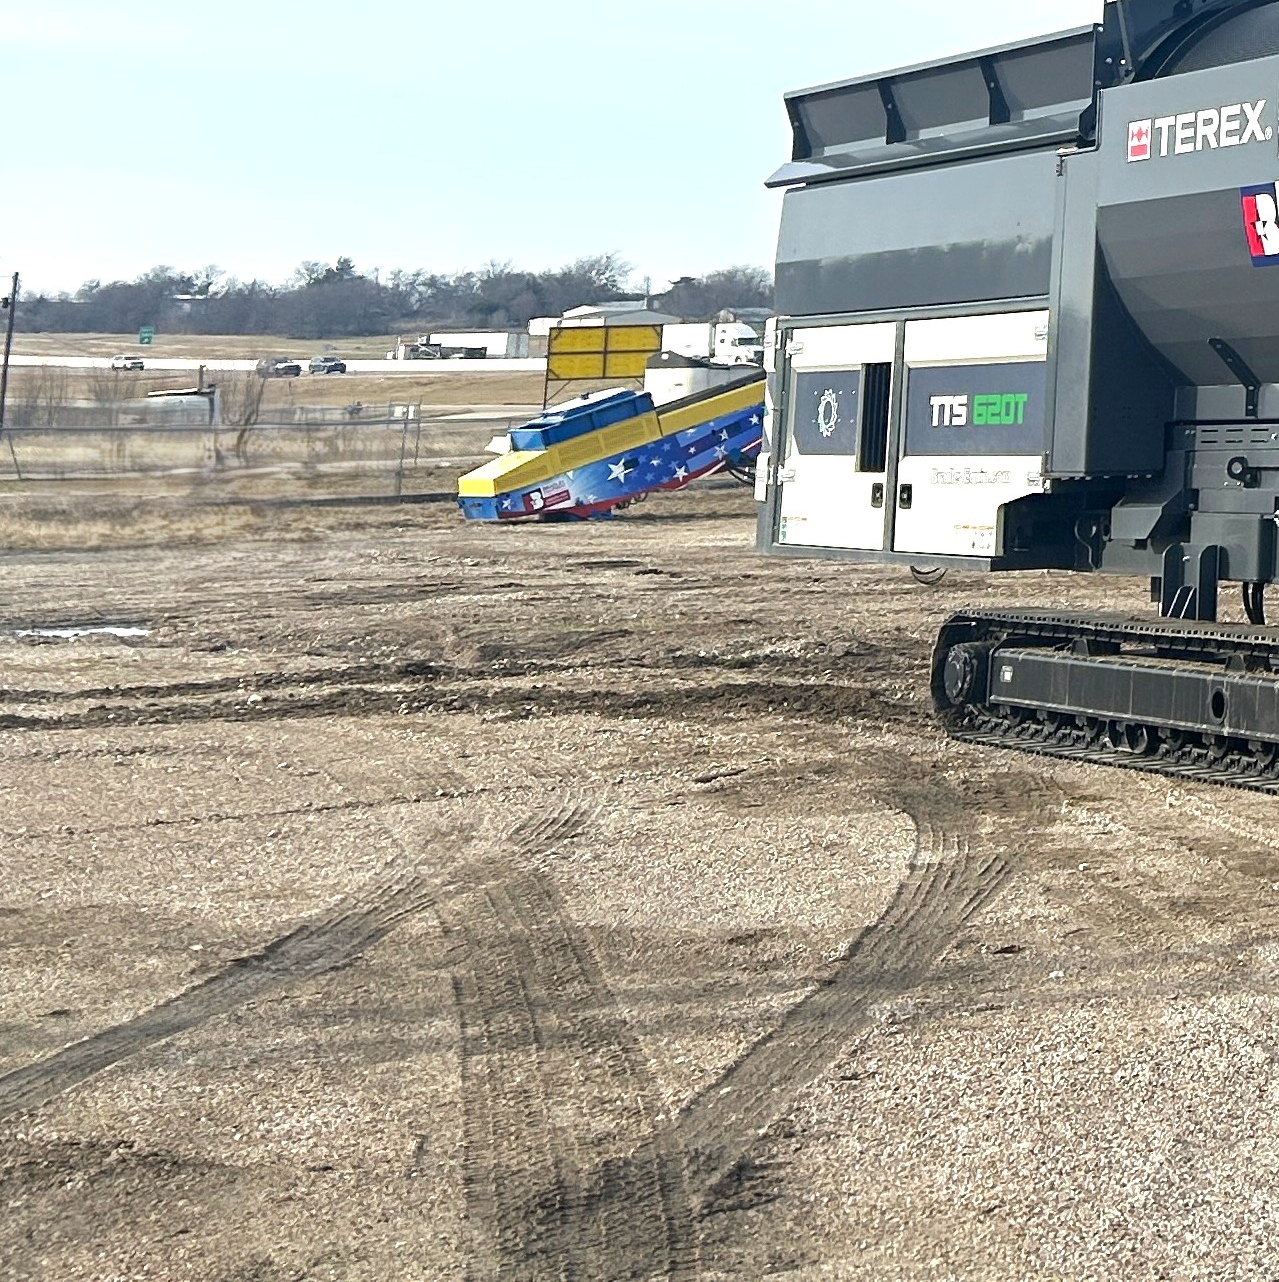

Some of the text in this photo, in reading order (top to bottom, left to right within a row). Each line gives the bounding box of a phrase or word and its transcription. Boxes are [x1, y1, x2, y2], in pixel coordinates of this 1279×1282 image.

[1154, 99, 1268, 157] TEREX
[930, 393, 1028, 427] TTS 620T
